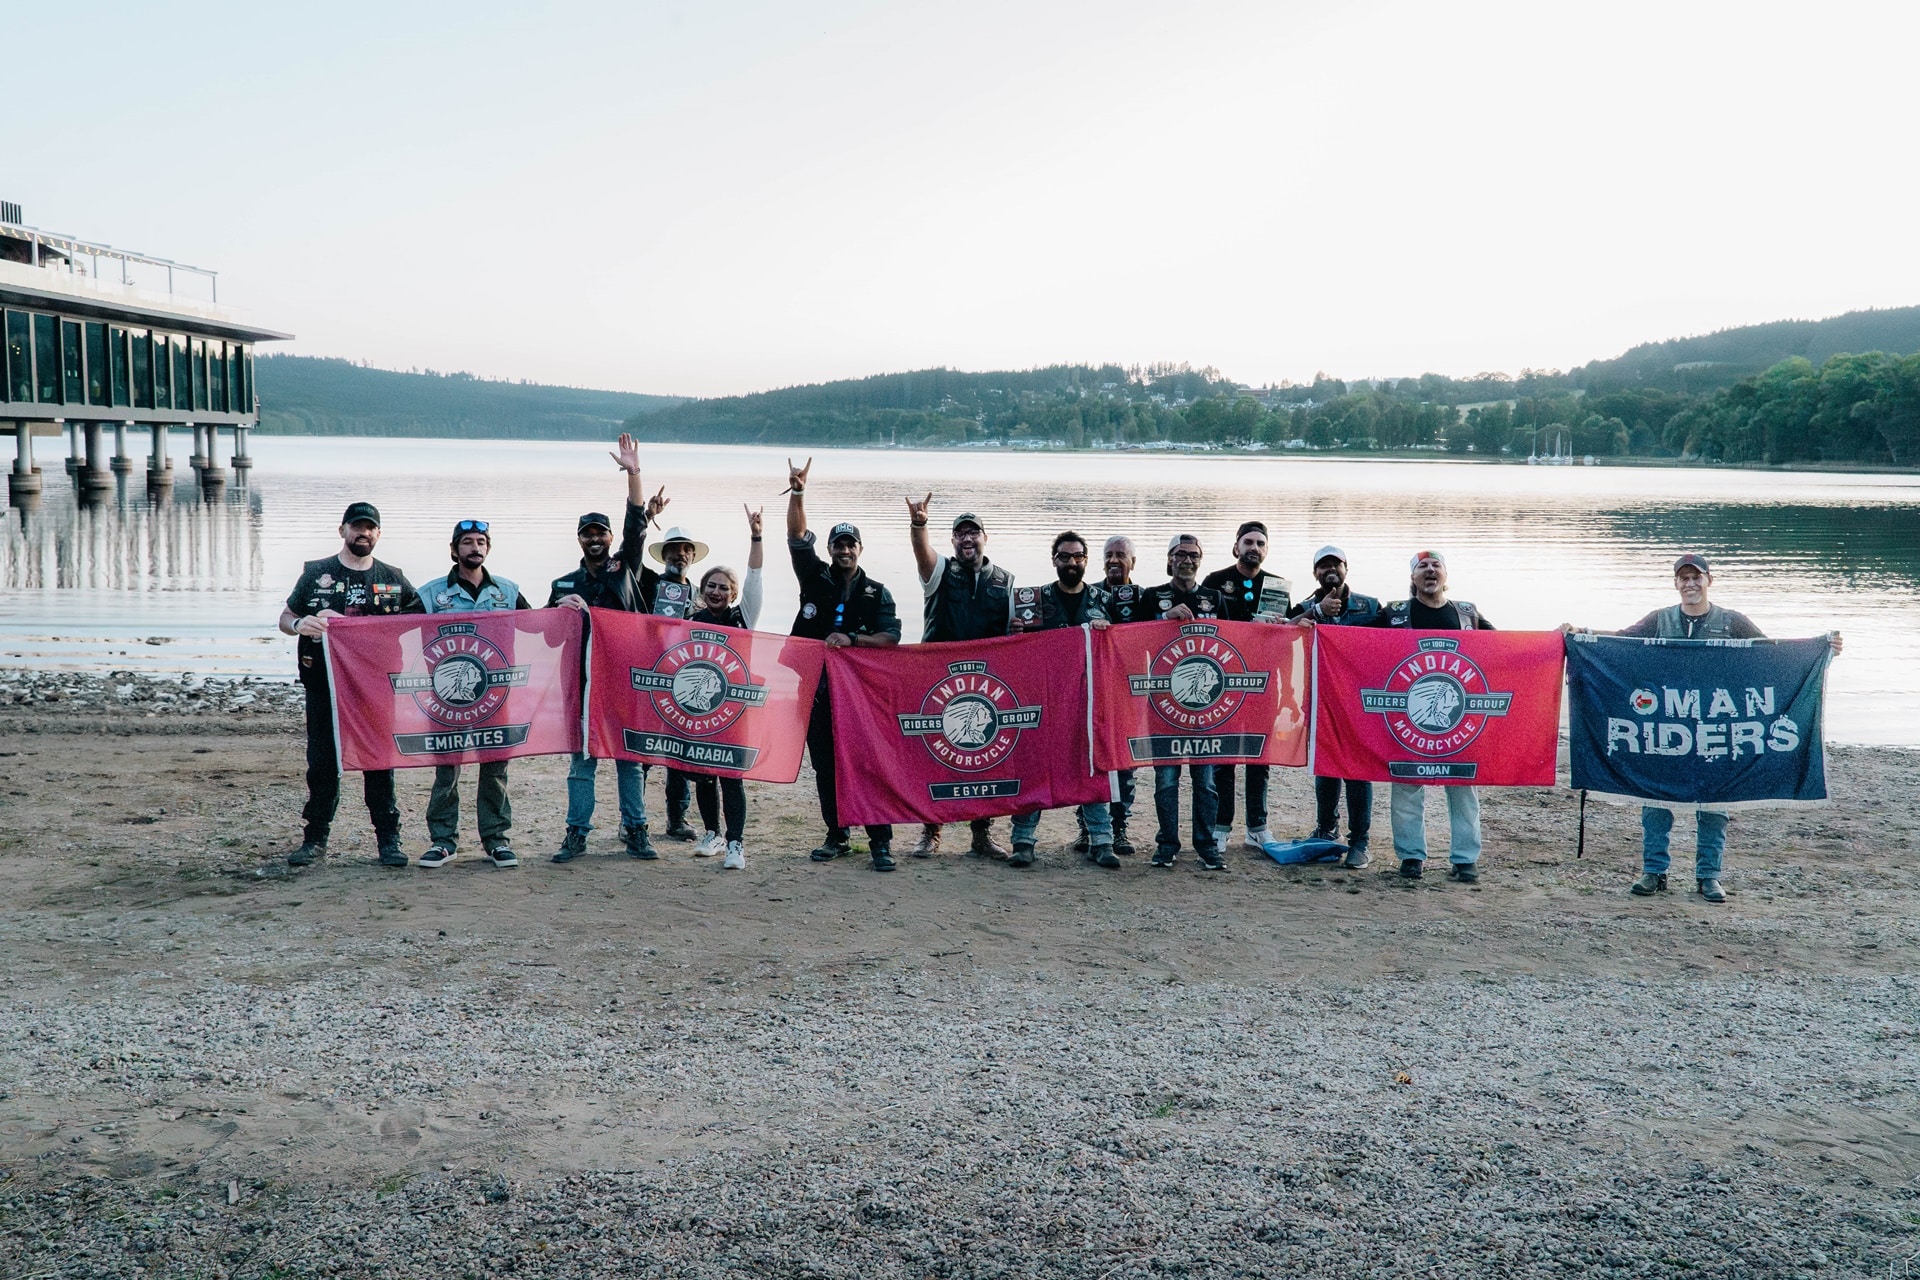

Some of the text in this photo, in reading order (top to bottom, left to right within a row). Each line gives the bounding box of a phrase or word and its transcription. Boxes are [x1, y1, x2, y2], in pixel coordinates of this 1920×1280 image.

[424, 638, 495, 665] INDIAN
[668, 644, 740, 675] INDIAN
[1162, 639, 1234, 665] INDIAN
[395, 672, 525, 688] RIDERS GROUP
[1399, 655, 1476, 684] INDIAN
[635, 675, 764, 700] RIDERS GROUP
[931, 676, 1006, 705] INDIAN
[1133, 678, 1263, 689] RIDERS GROUP
[424, 693, 499, 721] MOTORCYCLE
[659, 697, 734, 731] MOTORCYCLE
[1159, 696, 1234, 725] MOTORCYCLE
[1366, 696, 1505, 709] RIDERS GROUP
[1630, 686, 1774, 718] OMAN
[904, 712, 1037, 729] RIDERS GROUP
[424, 730, 504, 751] EMIRATES
[1171, 739, 1222, 756] QATAR
[1394, 719, 1476, 750] MOTORCYCLE
[1607, 715, 1800, 762] RIDERS
[645, 738, 734, 764] SAUDI ARABIA
[932, 735, 1010, 766] MOTORCYCLE
[1417, 765, 1450, 776] OMAN
[953, 784, 998, 797] EGYPT
